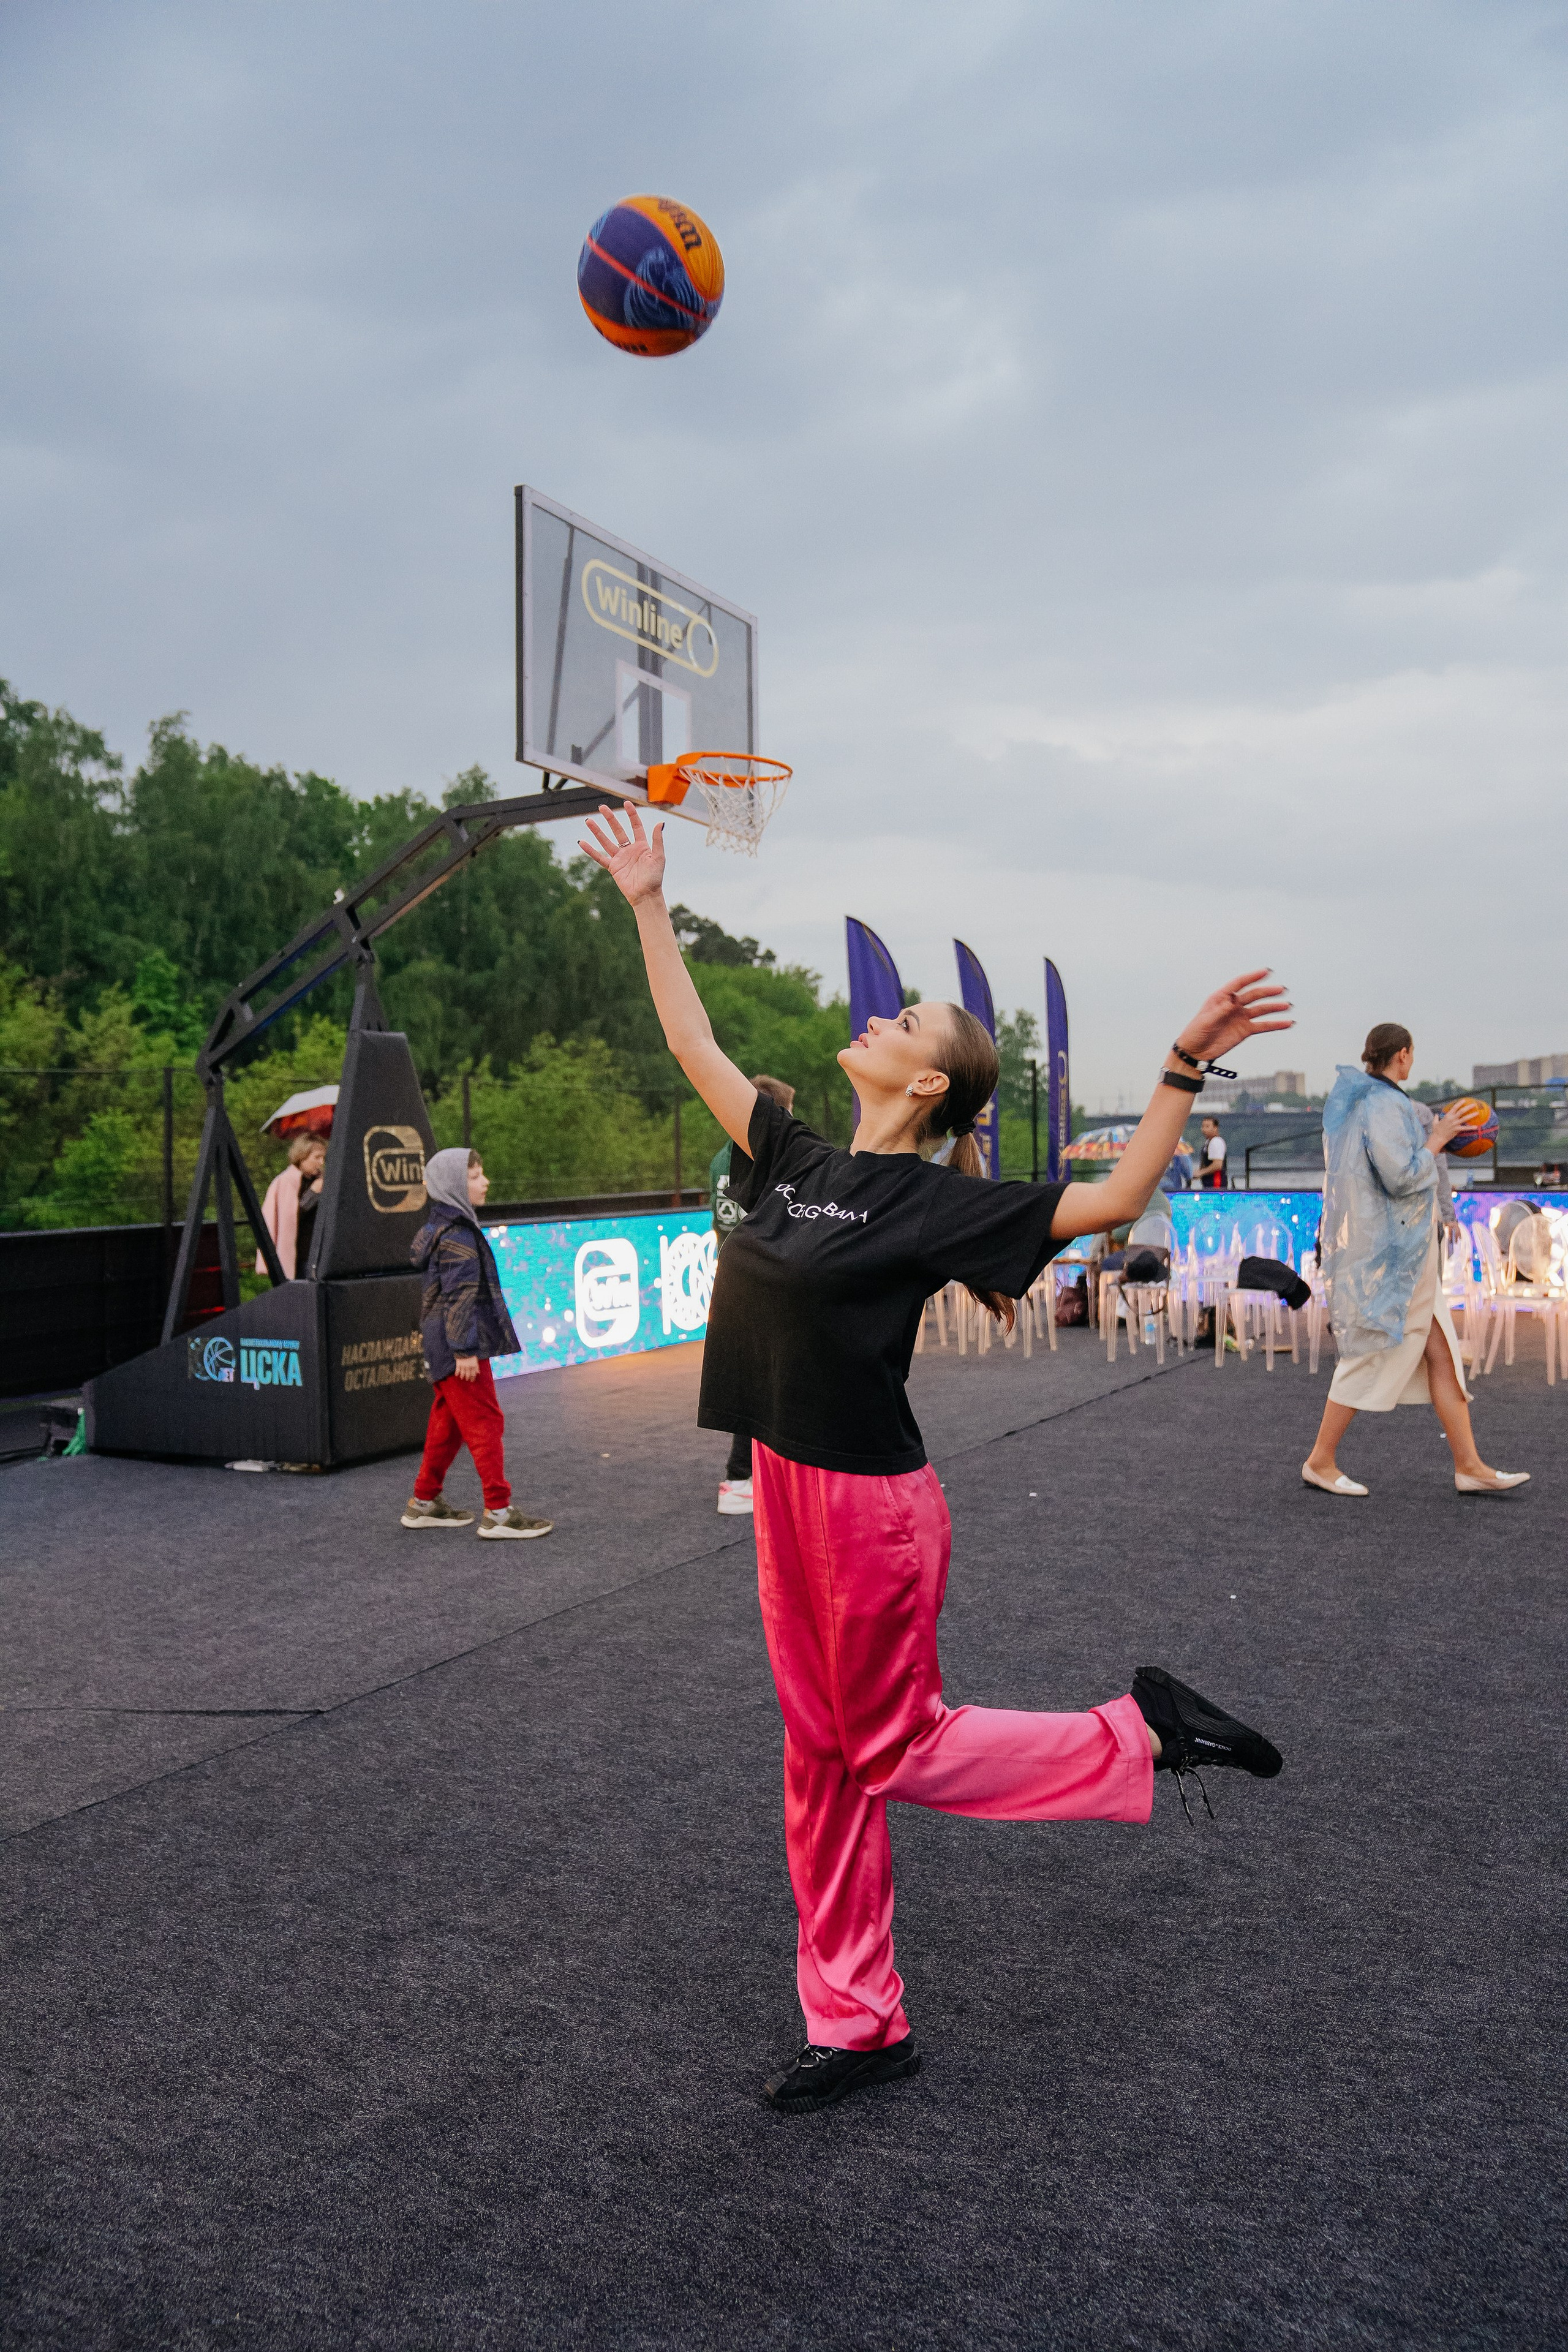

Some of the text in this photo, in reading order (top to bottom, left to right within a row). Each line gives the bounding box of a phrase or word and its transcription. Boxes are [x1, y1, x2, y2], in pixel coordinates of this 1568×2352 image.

[595, 575, 683, 649] Winline
[379, 1157, 422, 1182] Win
[239, 1349, 303, 1390] ЦСКА
